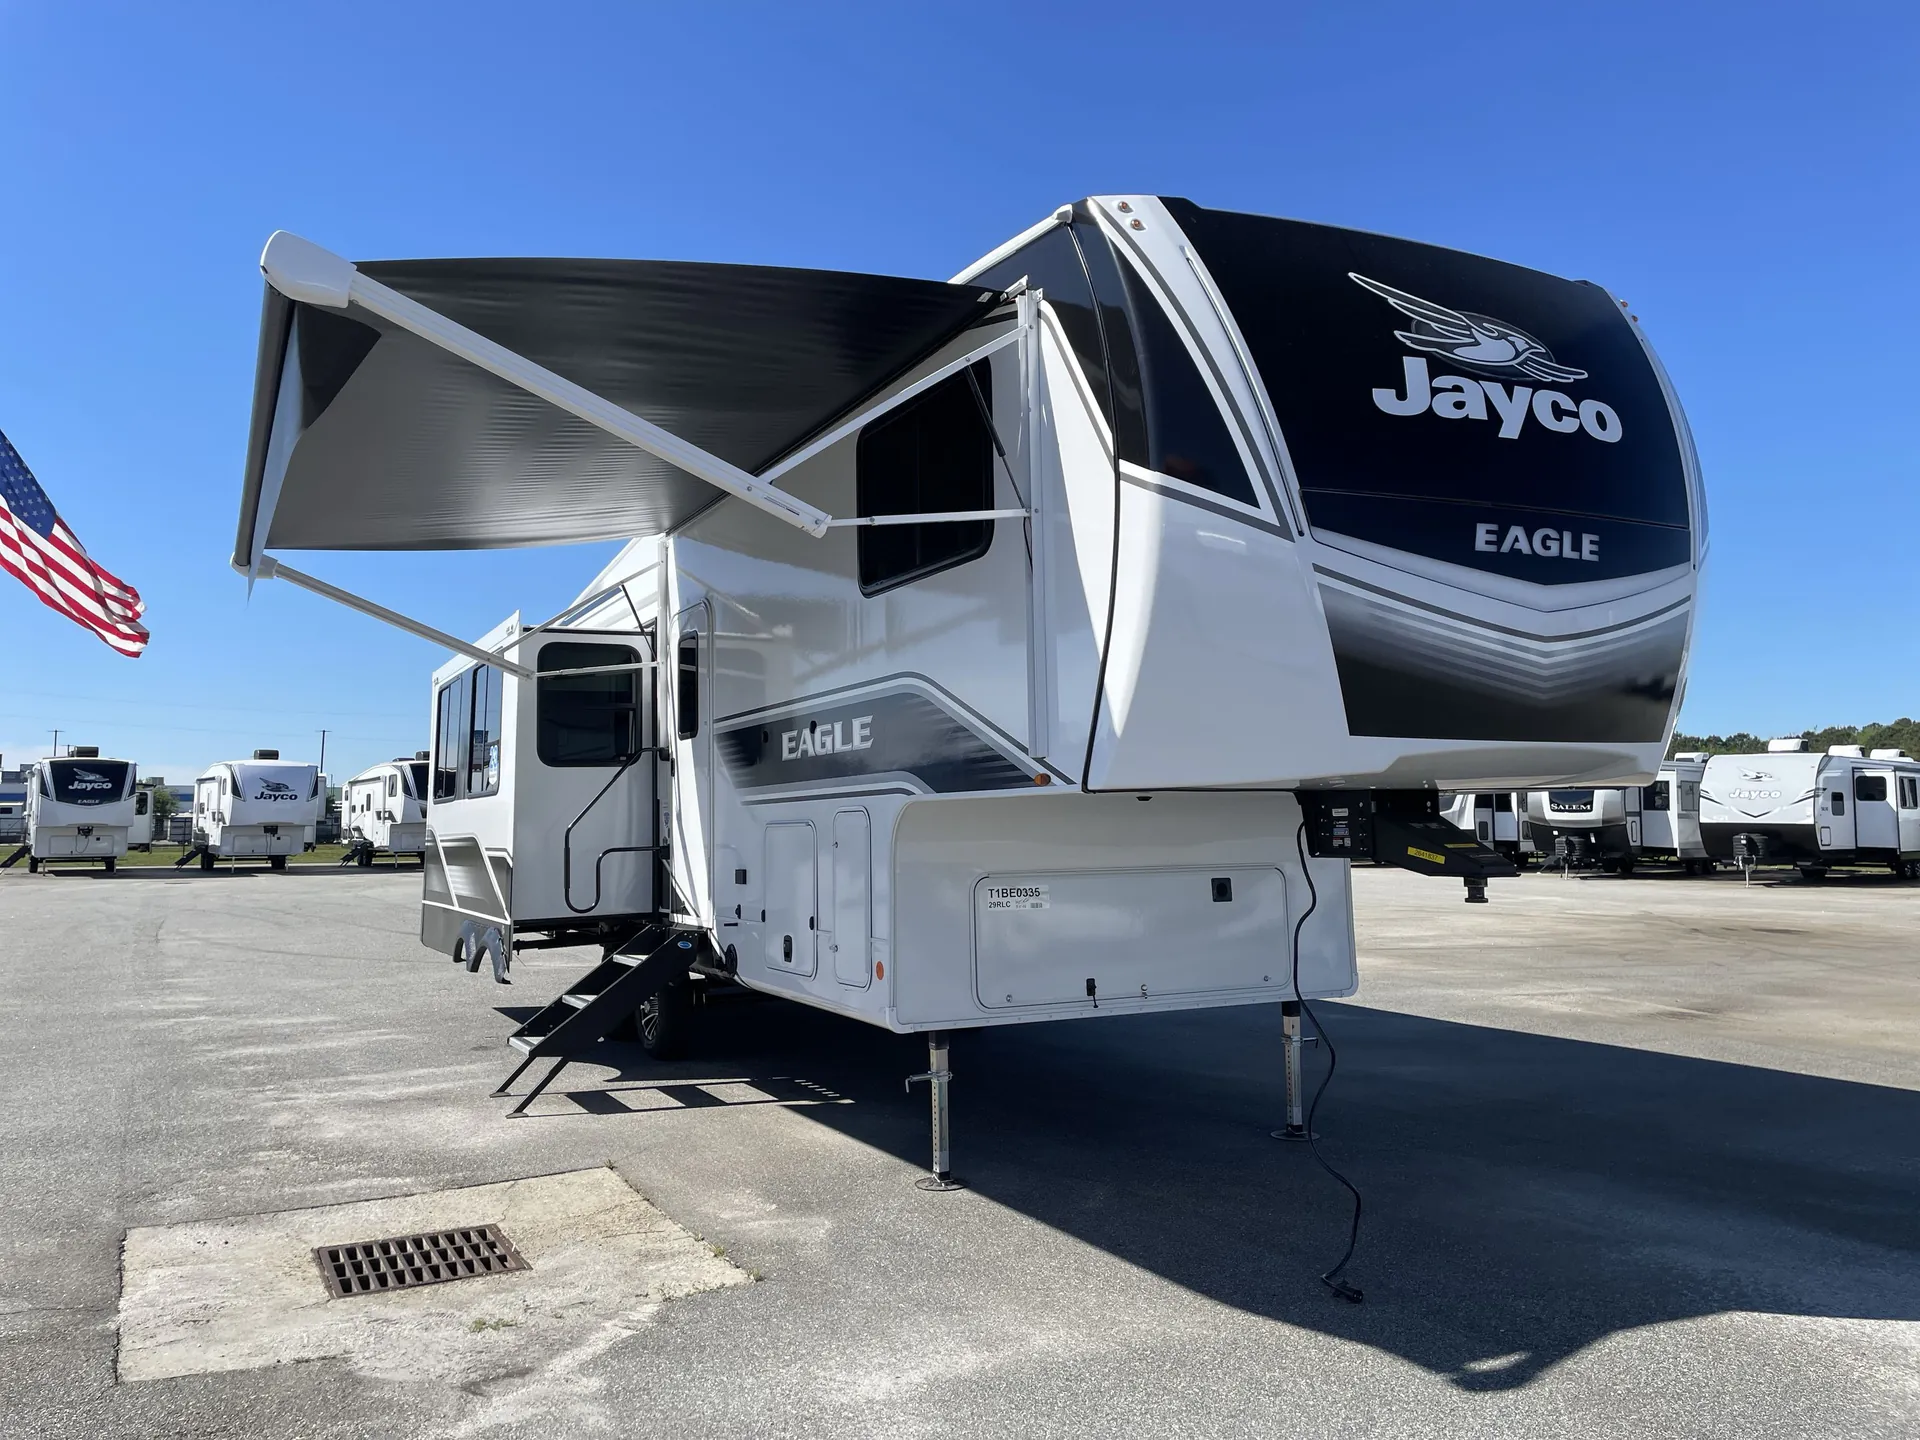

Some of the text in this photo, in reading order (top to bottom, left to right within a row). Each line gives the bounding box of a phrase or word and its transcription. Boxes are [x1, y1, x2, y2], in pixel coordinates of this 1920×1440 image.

[1372, 355, 1623, 443] Jayco
[1474, 523, 1600, 561] EAGLE
[781, 715, 874, 761] EAGLE
[68, 781, 113, 791] Jayco
[254, 791, 298, 802] Jayco
[1729, 788, 1782, 801] Jayco
[1550, 803, 1591, 811] SALEM
[988, 888, 1040, 898] T1BE0335
[988, 901, 1011, 909] 29RLC
